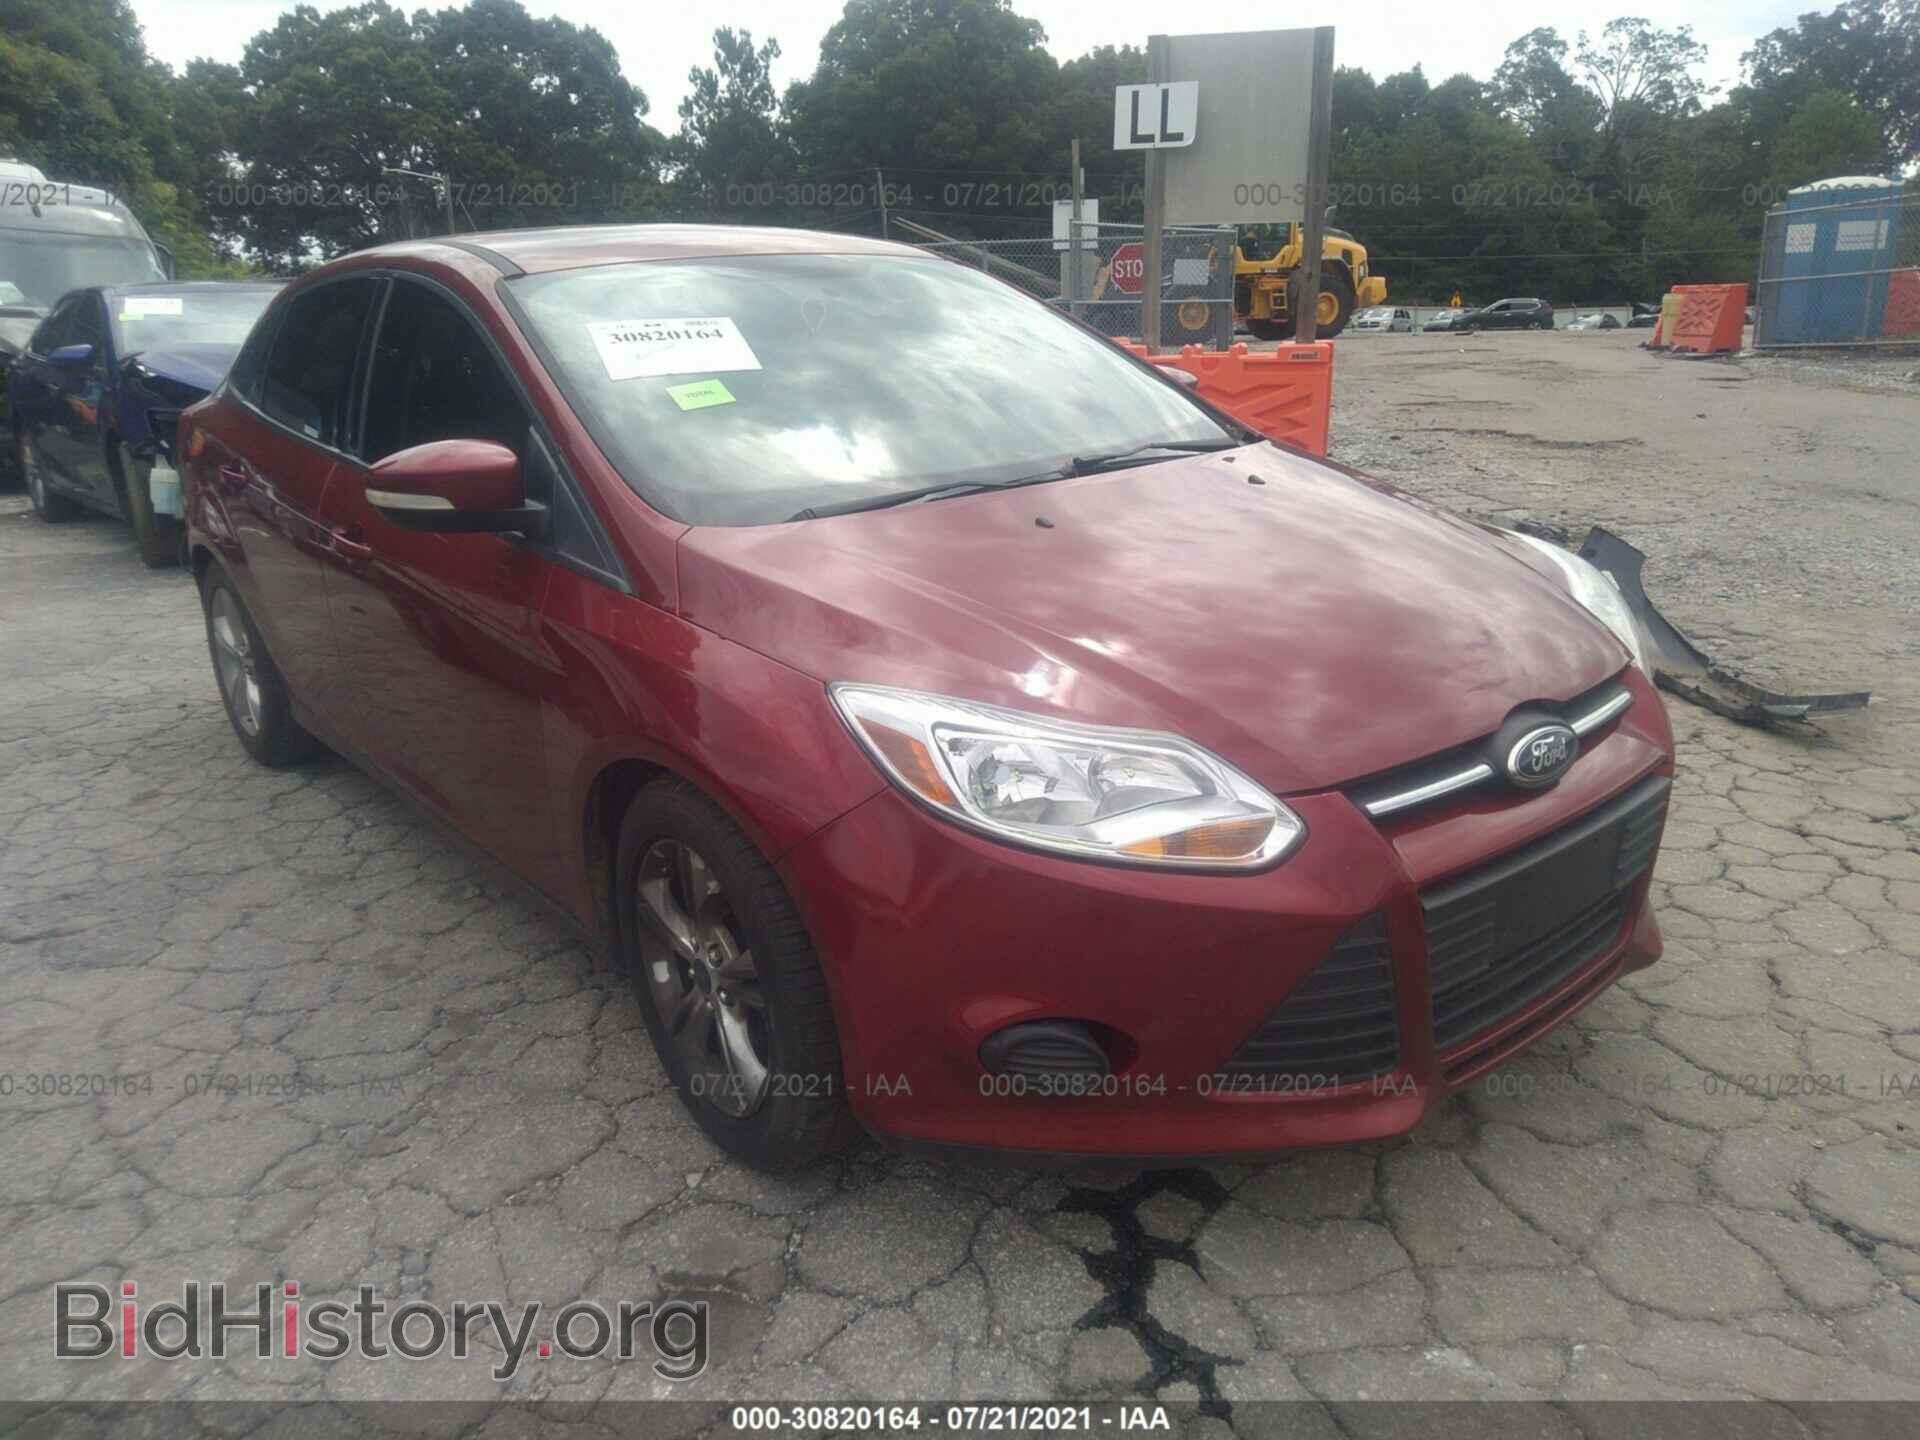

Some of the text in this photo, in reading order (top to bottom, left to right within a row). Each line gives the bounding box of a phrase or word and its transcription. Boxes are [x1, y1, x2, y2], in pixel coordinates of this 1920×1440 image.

[1129, 87, 1184, 144] LL
[1114, 258, 1144, 279] STO
[608, 328, 724, 345] 30820164
